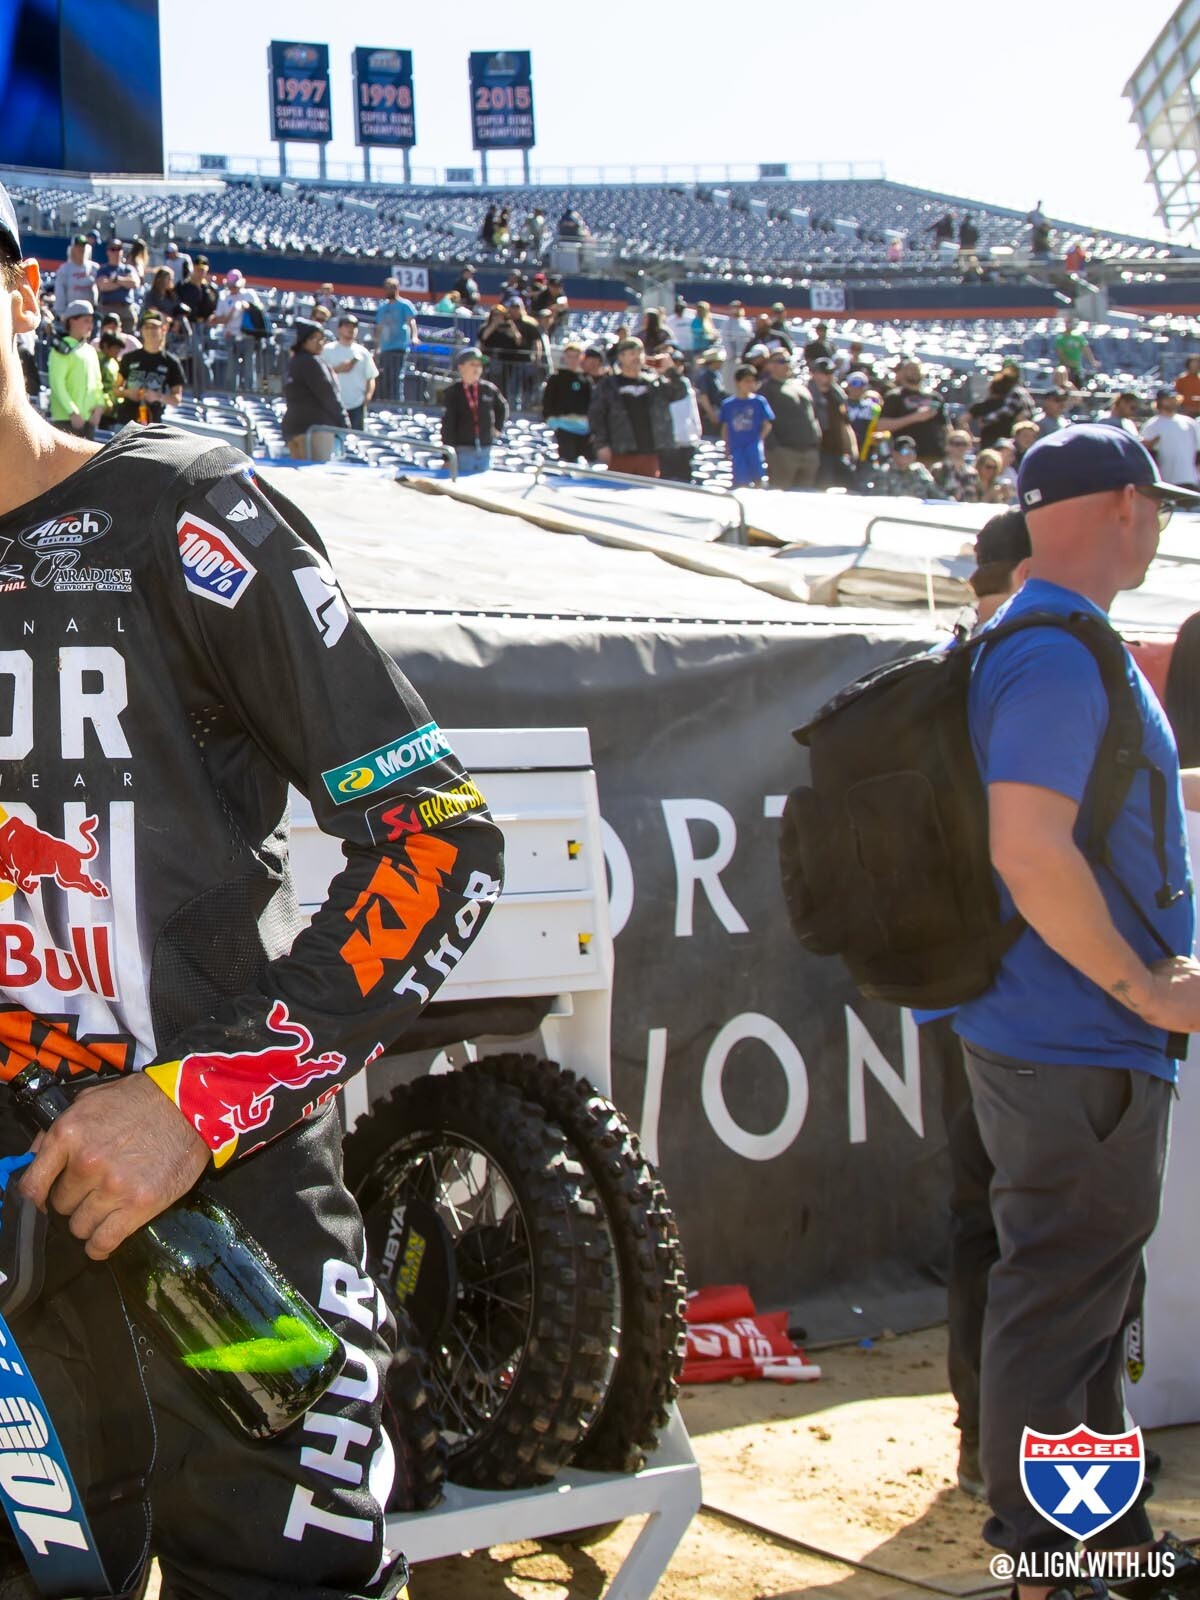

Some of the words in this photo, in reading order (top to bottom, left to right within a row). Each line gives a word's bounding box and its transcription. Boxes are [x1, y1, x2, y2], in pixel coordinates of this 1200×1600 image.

[276, 77, 327, 102] 1997
[360, 82, 411, 108] 1998
[475, 86, 530, 110] 2015
[26, 513, 99, 540] Airoh
[180, 532, 243, 593] 100%
[54, 583, 93, 592] CHEVROLET
[339, 833, 458, 997] KTM
[393, 870, 501, 1004] THOR
